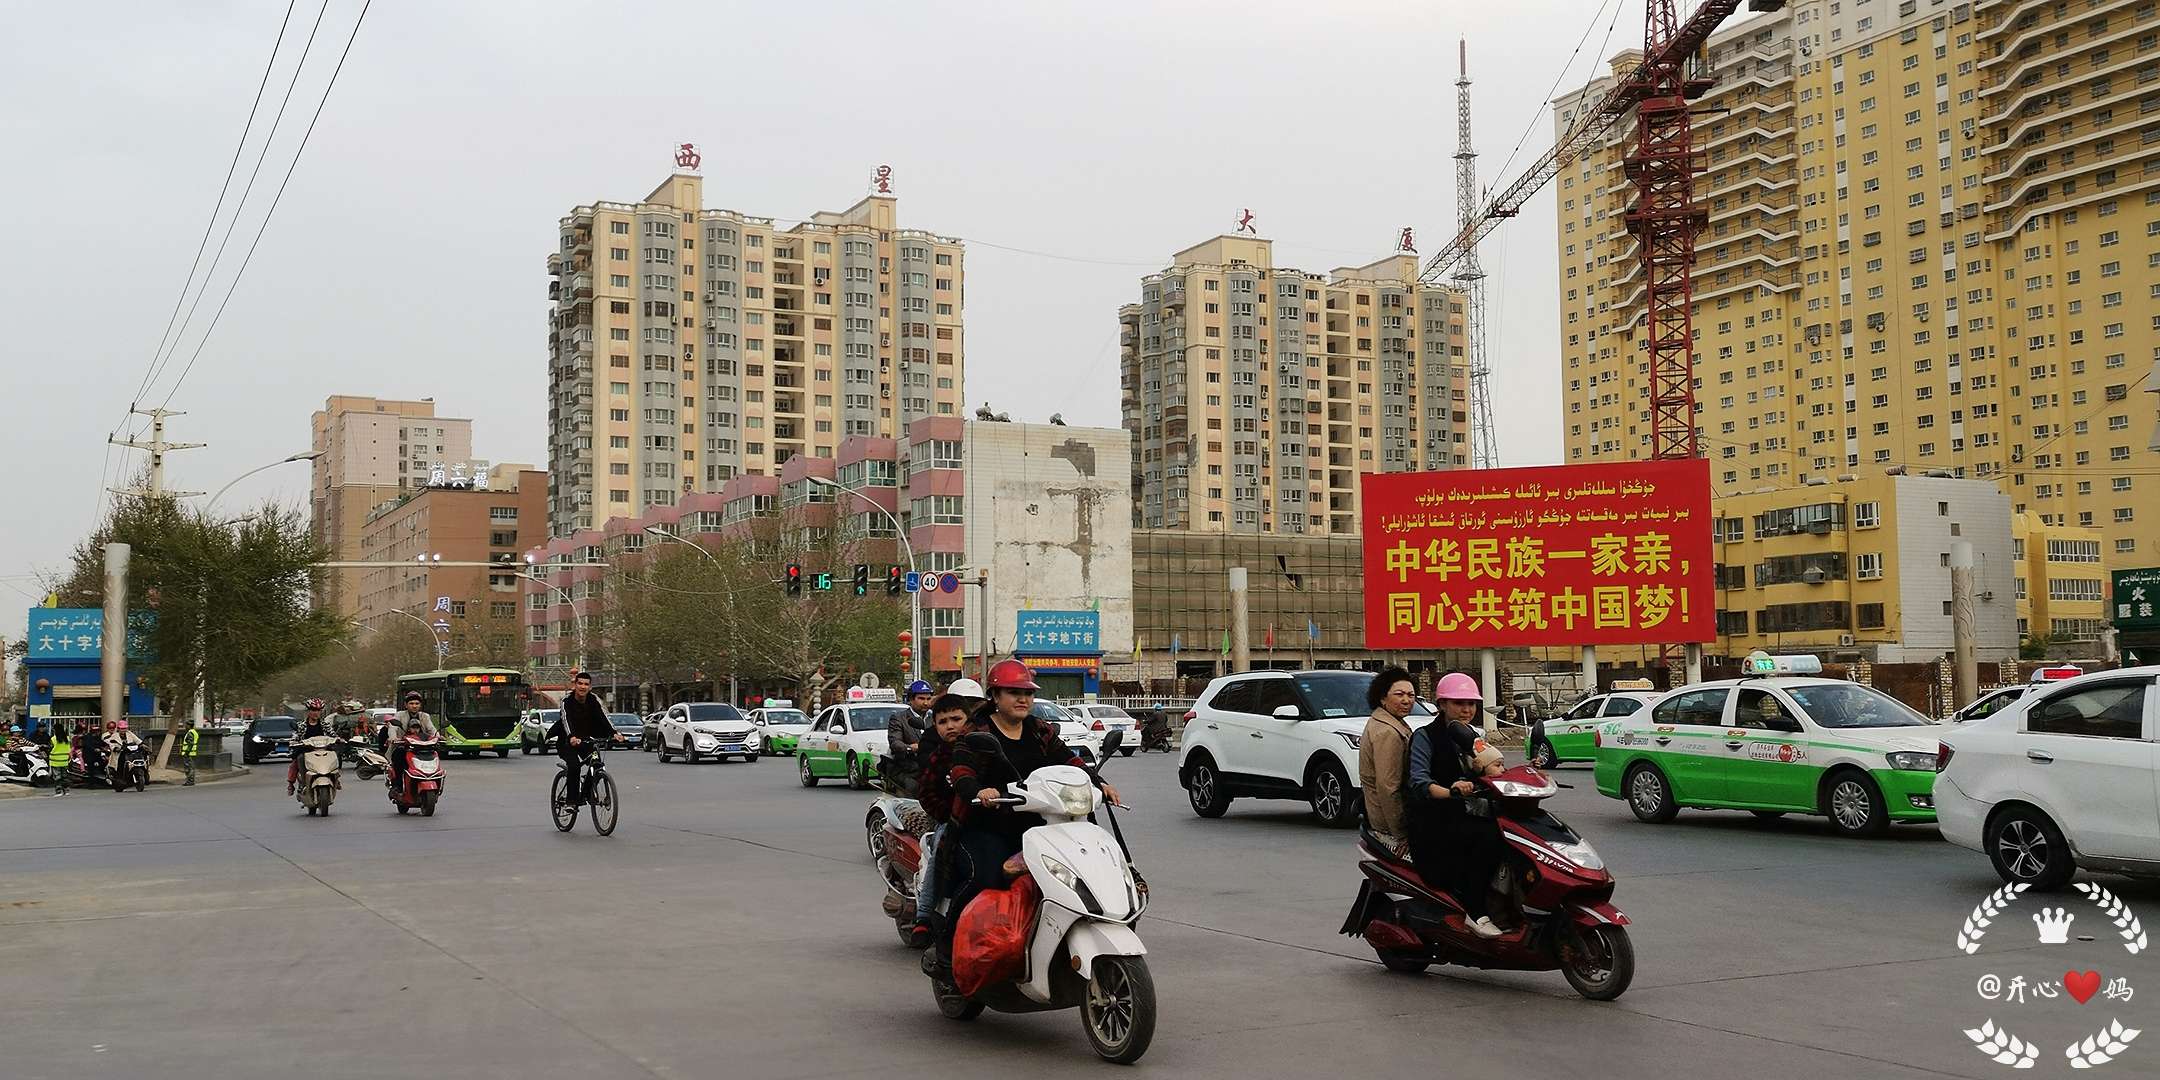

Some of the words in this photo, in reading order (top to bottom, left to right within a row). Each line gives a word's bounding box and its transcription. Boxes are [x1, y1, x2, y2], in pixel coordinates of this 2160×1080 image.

[675, 143, 701, 170] 西
[873, 165, 892, 193] 星
[1238, 208, 1257, 234] 大
[428, 470, 489, 488] 周六福
[1385, 532, 1689, 583] 中华民族一家亲，
[818, 573, 832, 590] 16
[924, 577, 936, 588] 40
[1388, 583, 1689, 634] 同心共筑中国梦！
[1023, 631, 1093, 645] 大十字地下街
